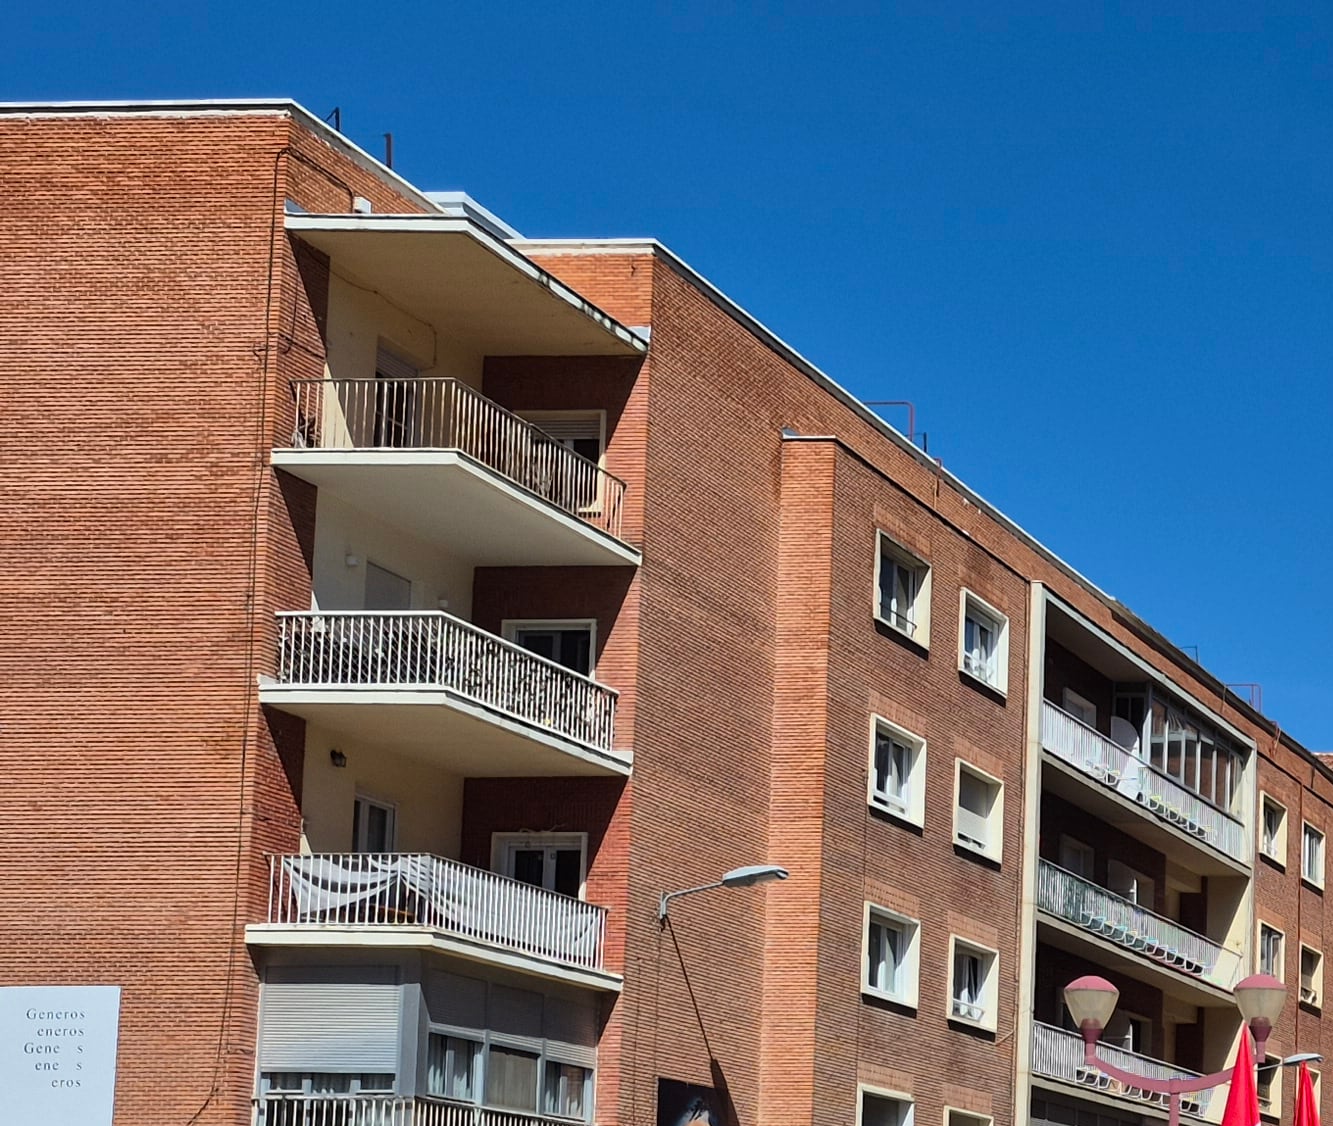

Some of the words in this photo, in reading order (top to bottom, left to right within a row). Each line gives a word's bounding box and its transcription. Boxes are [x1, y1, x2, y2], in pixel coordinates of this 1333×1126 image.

[26, 1008, 85, 1020] Generos
[37, 1027, 84, 1037] eneros
[24, 1042, 60, 1054] Gene
[35, 1062, 59, 1071] ene
[51, 1079, 81, 1088] eros
